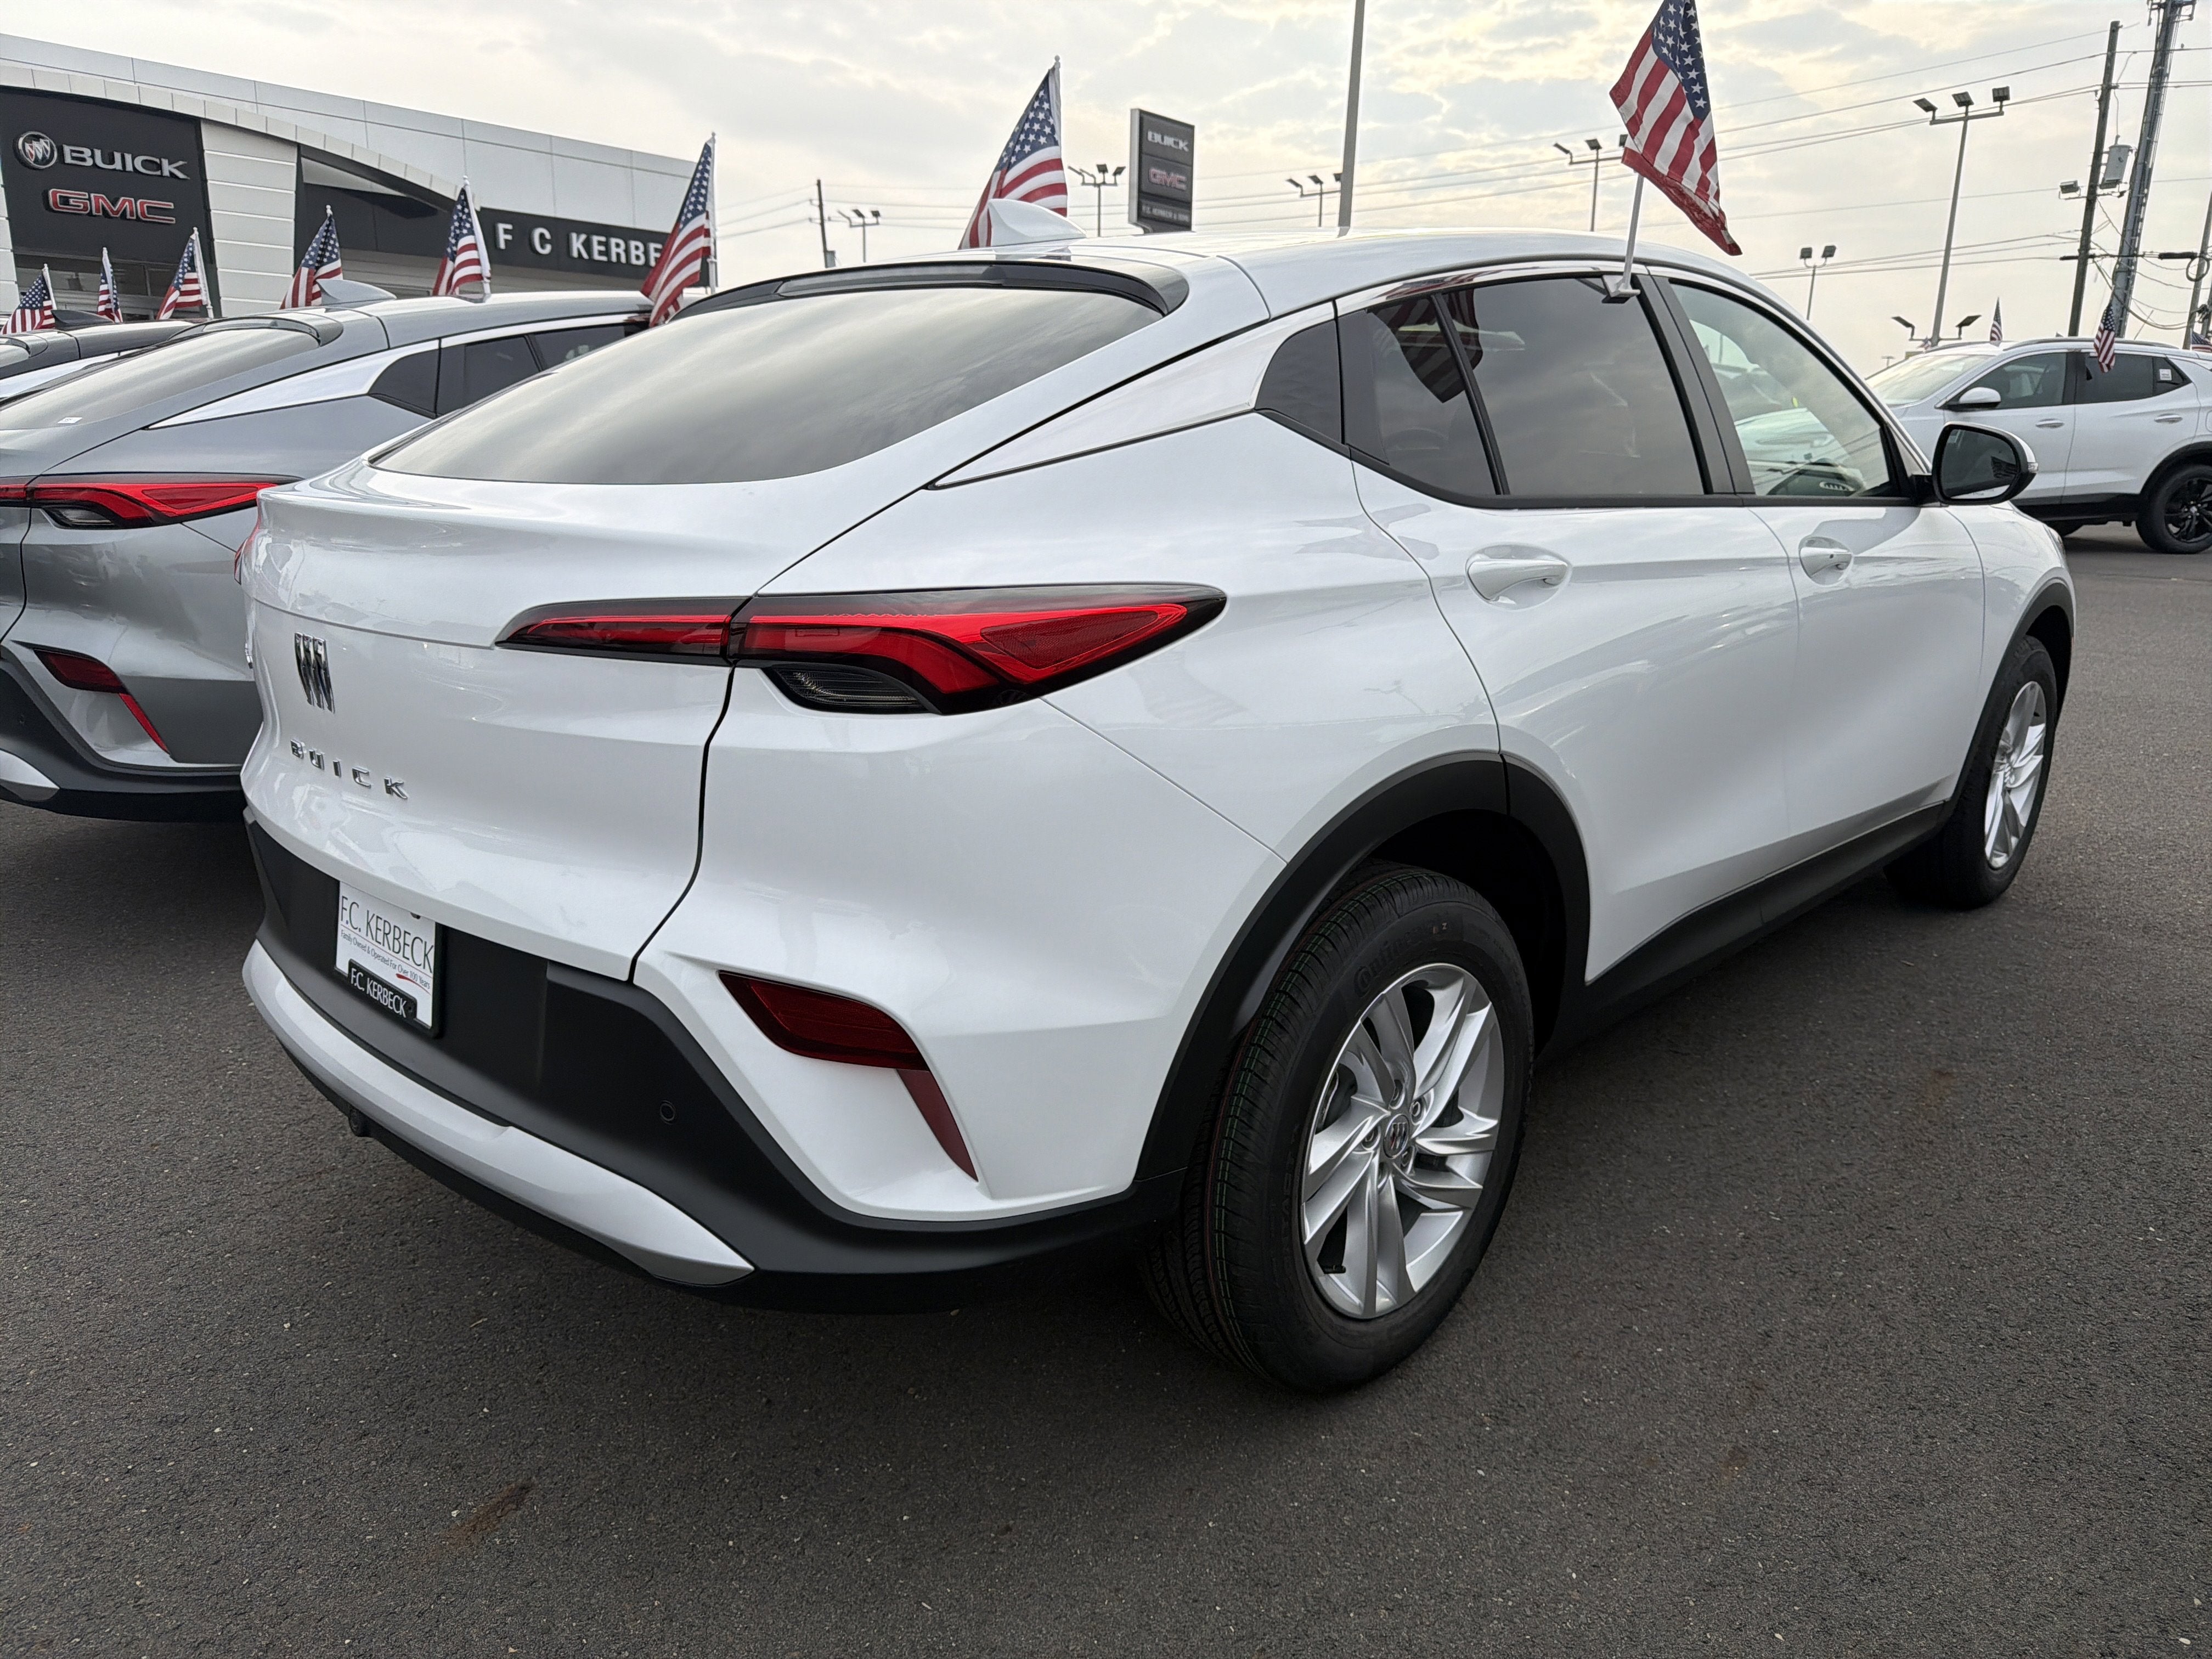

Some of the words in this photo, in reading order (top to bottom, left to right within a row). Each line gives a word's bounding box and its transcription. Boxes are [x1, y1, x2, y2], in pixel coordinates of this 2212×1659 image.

[62, 144, 190, 180] BUICK
[1148, 131, 1189, 151] BUICK
[1149, 168, 1187, 190] GMC
[48, 188, 176, 224] GMC
[496, 222, 514, 250] F
[531, 227, 552, 255] C
[569, 232, 663, 268] KERBE
[290, 739, 408, 800] BUICK
[341, 895, 362, 933] F.C.
[365, 909, 434, 974] KERBECK
[341, 929, 353, 945] Family
[353, 936, 366, 952] Owned
[370, 948, 389, 966] Operated
[397, 963, 409, 977] Over
[409, 970, 418, 982] 100
[419, 975, 431, 990] Years
[350, 967, 365, 991] F.C.
[366, 977, 407, 1018] KERBECK
